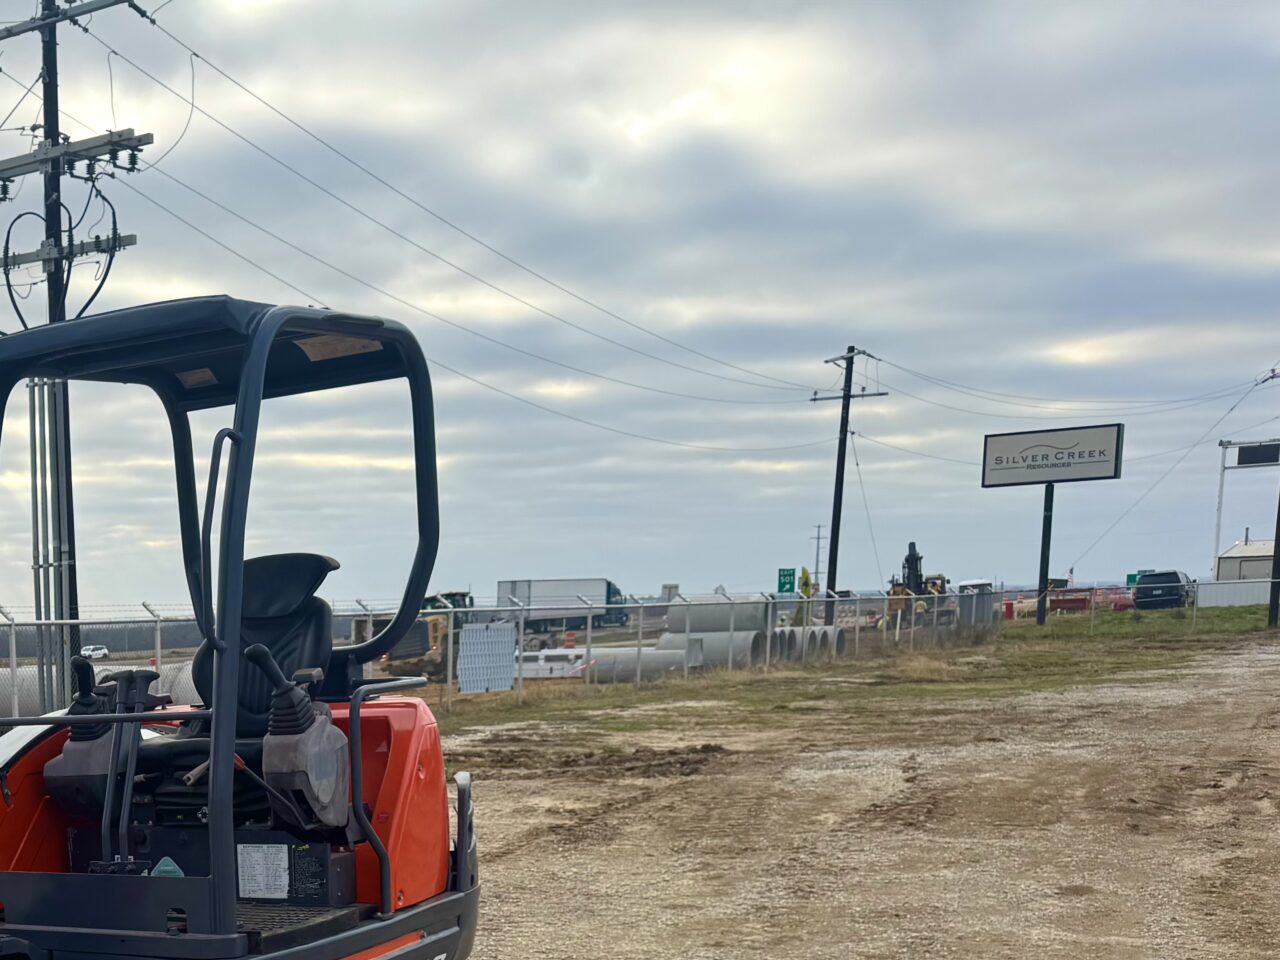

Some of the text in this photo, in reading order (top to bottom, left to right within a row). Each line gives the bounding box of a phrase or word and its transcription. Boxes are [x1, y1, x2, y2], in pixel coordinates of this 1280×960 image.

[994, 449, 1107, 465] SILVER CREEK
[1026, 462, 1072, 470] RESOURCES
